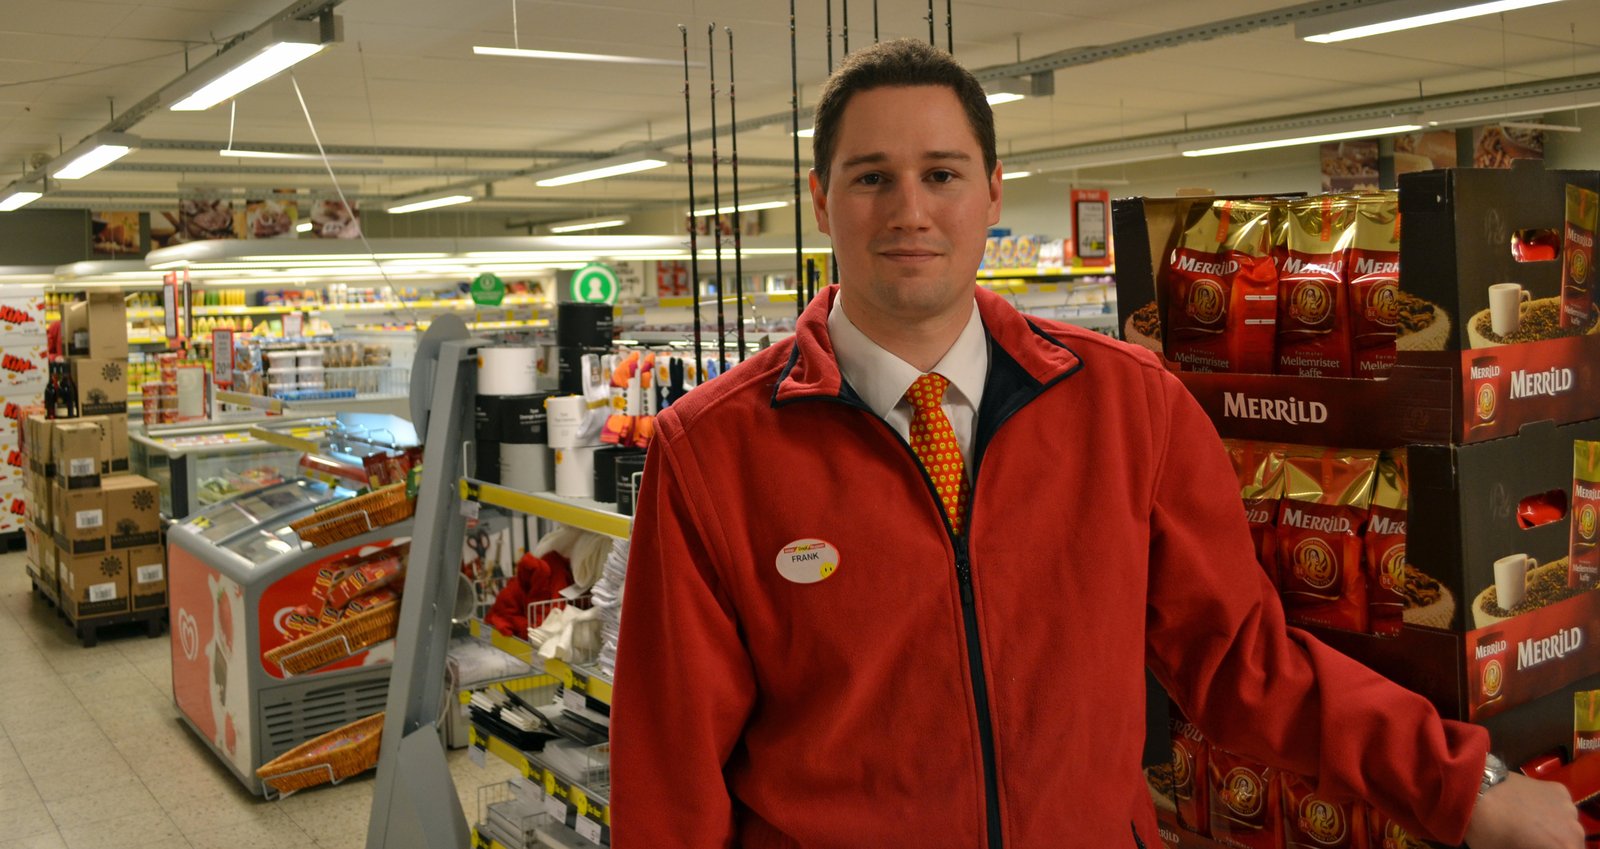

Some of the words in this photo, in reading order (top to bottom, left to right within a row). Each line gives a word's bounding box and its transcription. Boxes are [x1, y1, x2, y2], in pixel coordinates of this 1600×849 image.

[1178, 256, 1239, 276] MERRiLD
[1175, 352, 1230, 369] Mellemristet
[1280, 355, 1340, 369] Mellemristet
[1471, 365, 1500, 380] MERRiLD
[1510, 367, 1572, 400] MERRiLD
[1224, 392, 1328, 425] MERRiLD
[1282, 508, 1350, 533] MERRiLD
[792, 552, 819, 562] FRANK
[1476, 640, 1507, 660] MERRiLD
[1517, 627, 1581, 670] MERRiLD
